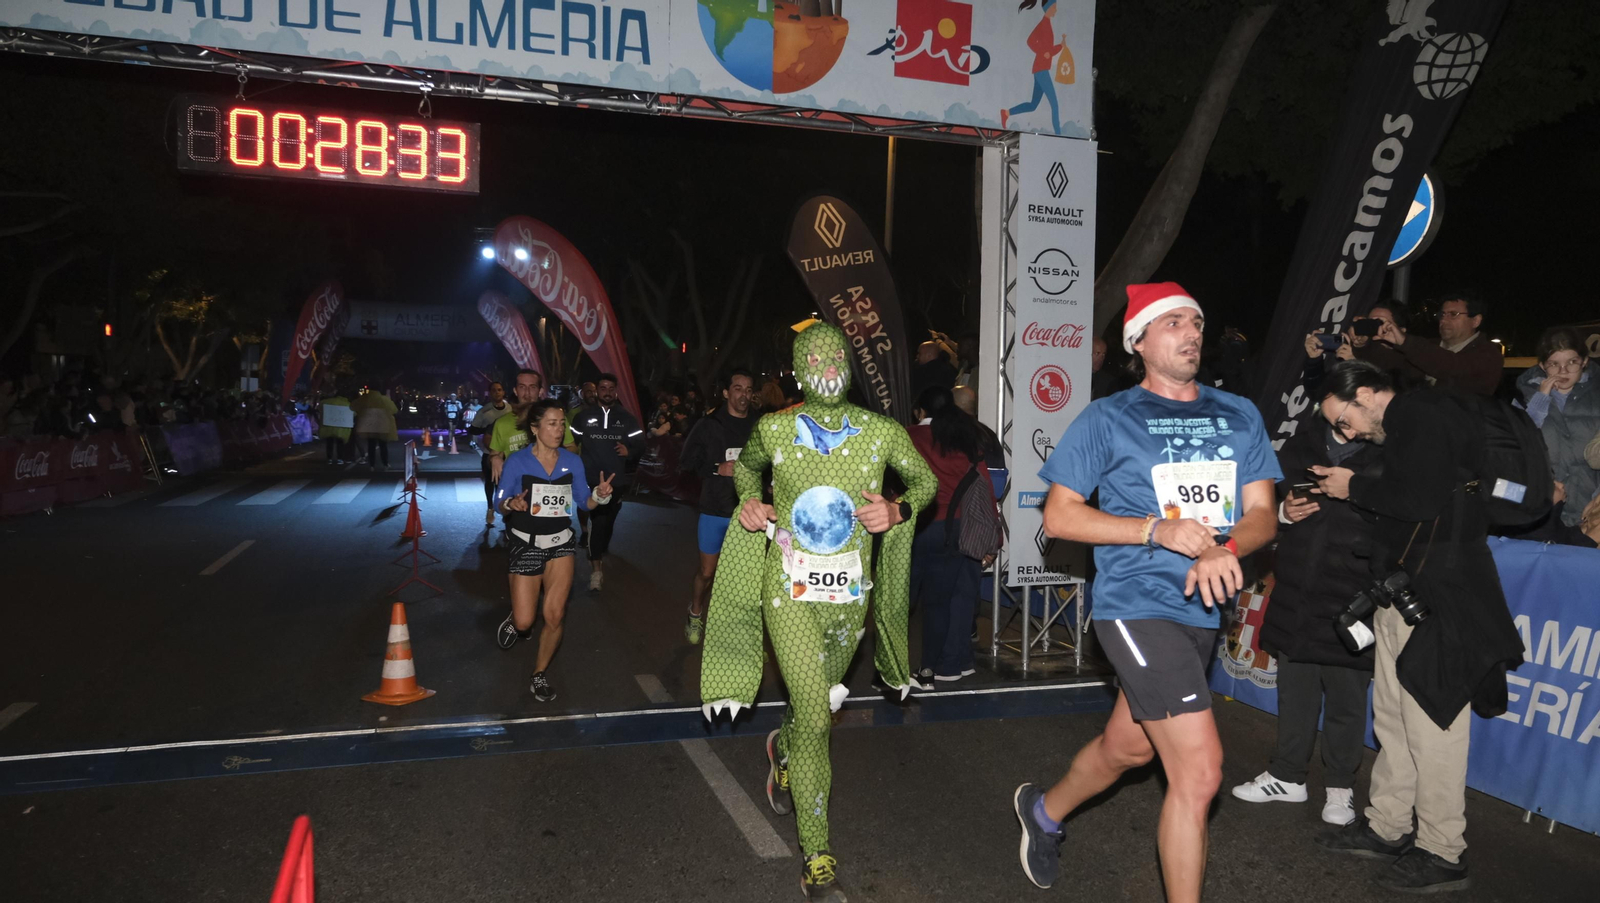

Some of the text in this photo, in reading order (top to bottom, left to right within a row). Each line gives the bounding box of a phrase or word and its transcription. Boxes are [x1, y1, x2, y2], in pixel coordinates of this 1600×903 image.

[229, 107, 467, 183] 00:28:33
[1028, 204, 1084, 218] RENAULT
[1028, 215, 1083, 227] SYRSA AUTOMOCION
[1028, 266, 1080, 277] NISSAN
[1032, 296, 1078, 306] andalmotor.es
[1022, 321, 1087, 348] Coca-Cola
[542, 495, 565, 506] 636
[1178, 484, 1220, 504] 986
[1017, 565, 1072, 575] RENAULT
[808, 571, 848, 586] 506
